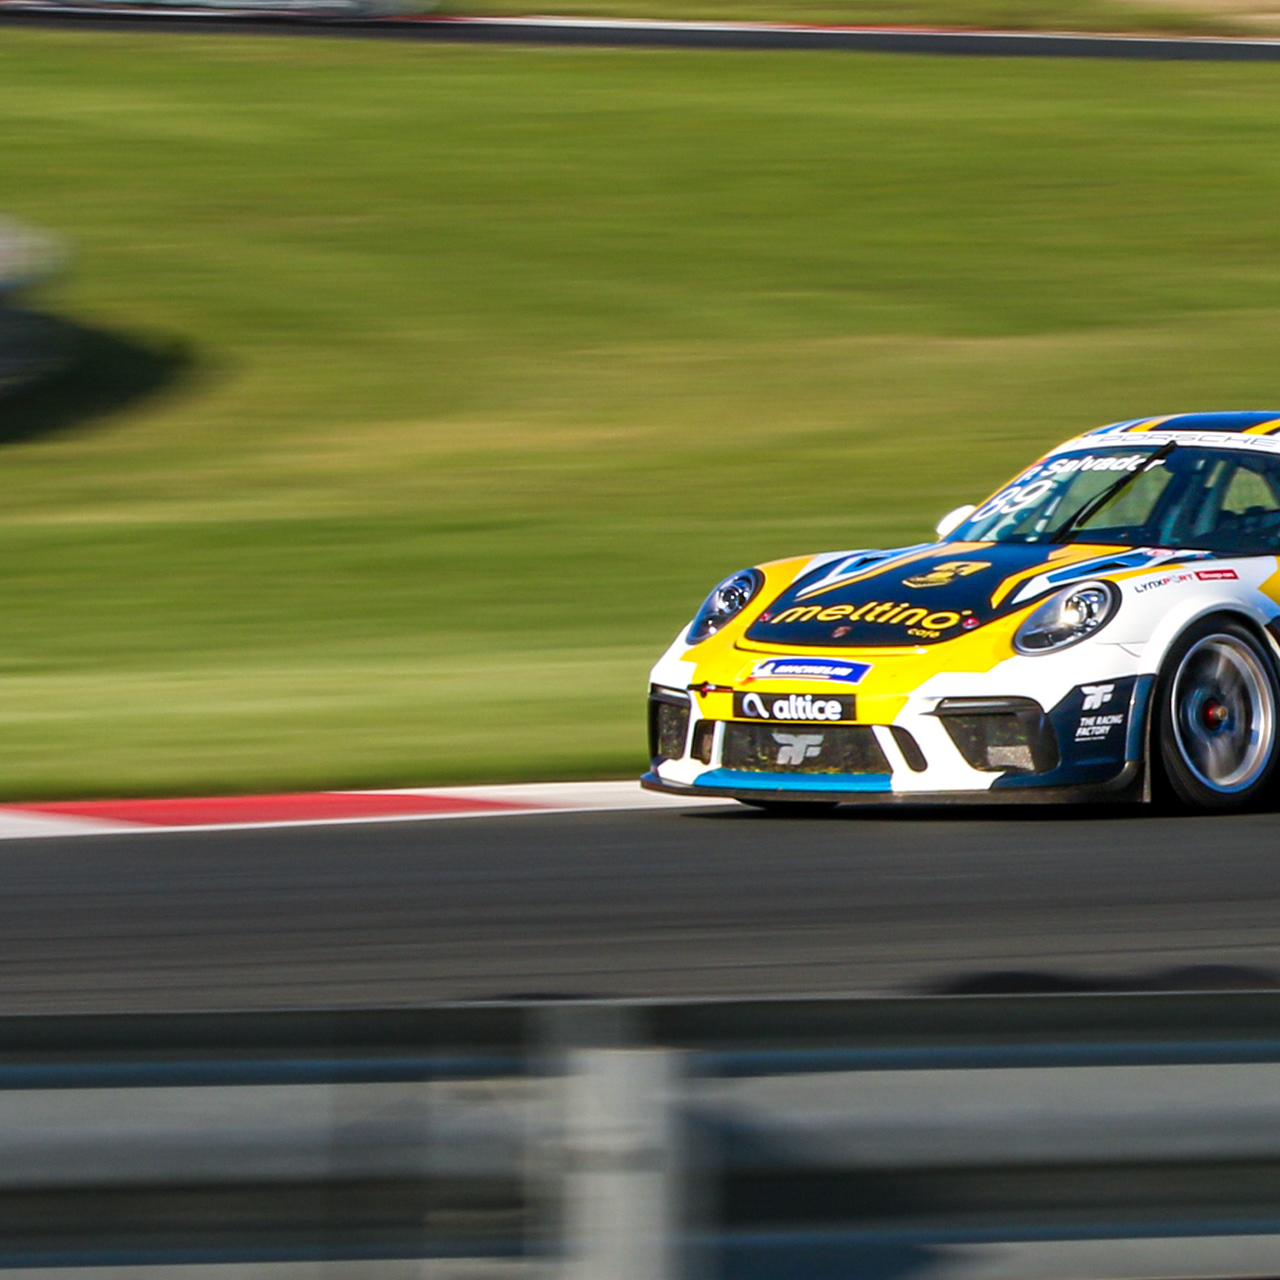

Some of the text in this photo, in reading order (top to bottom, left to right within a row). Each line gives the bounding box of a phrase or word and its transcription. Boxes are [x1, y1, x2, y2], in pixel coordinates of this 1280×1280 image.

[1098, 433, 1280, 448] PORSCHE
[970, 479, 1054, 523] 89
[770, 602, 960, 629] meltino
[773, 664, 854, 677] MICHELIN
[772, 694, 843, 721] altice
[1080, 716, 1097, 726] THE
[1075, 725, 1111, 737] FACTORY
